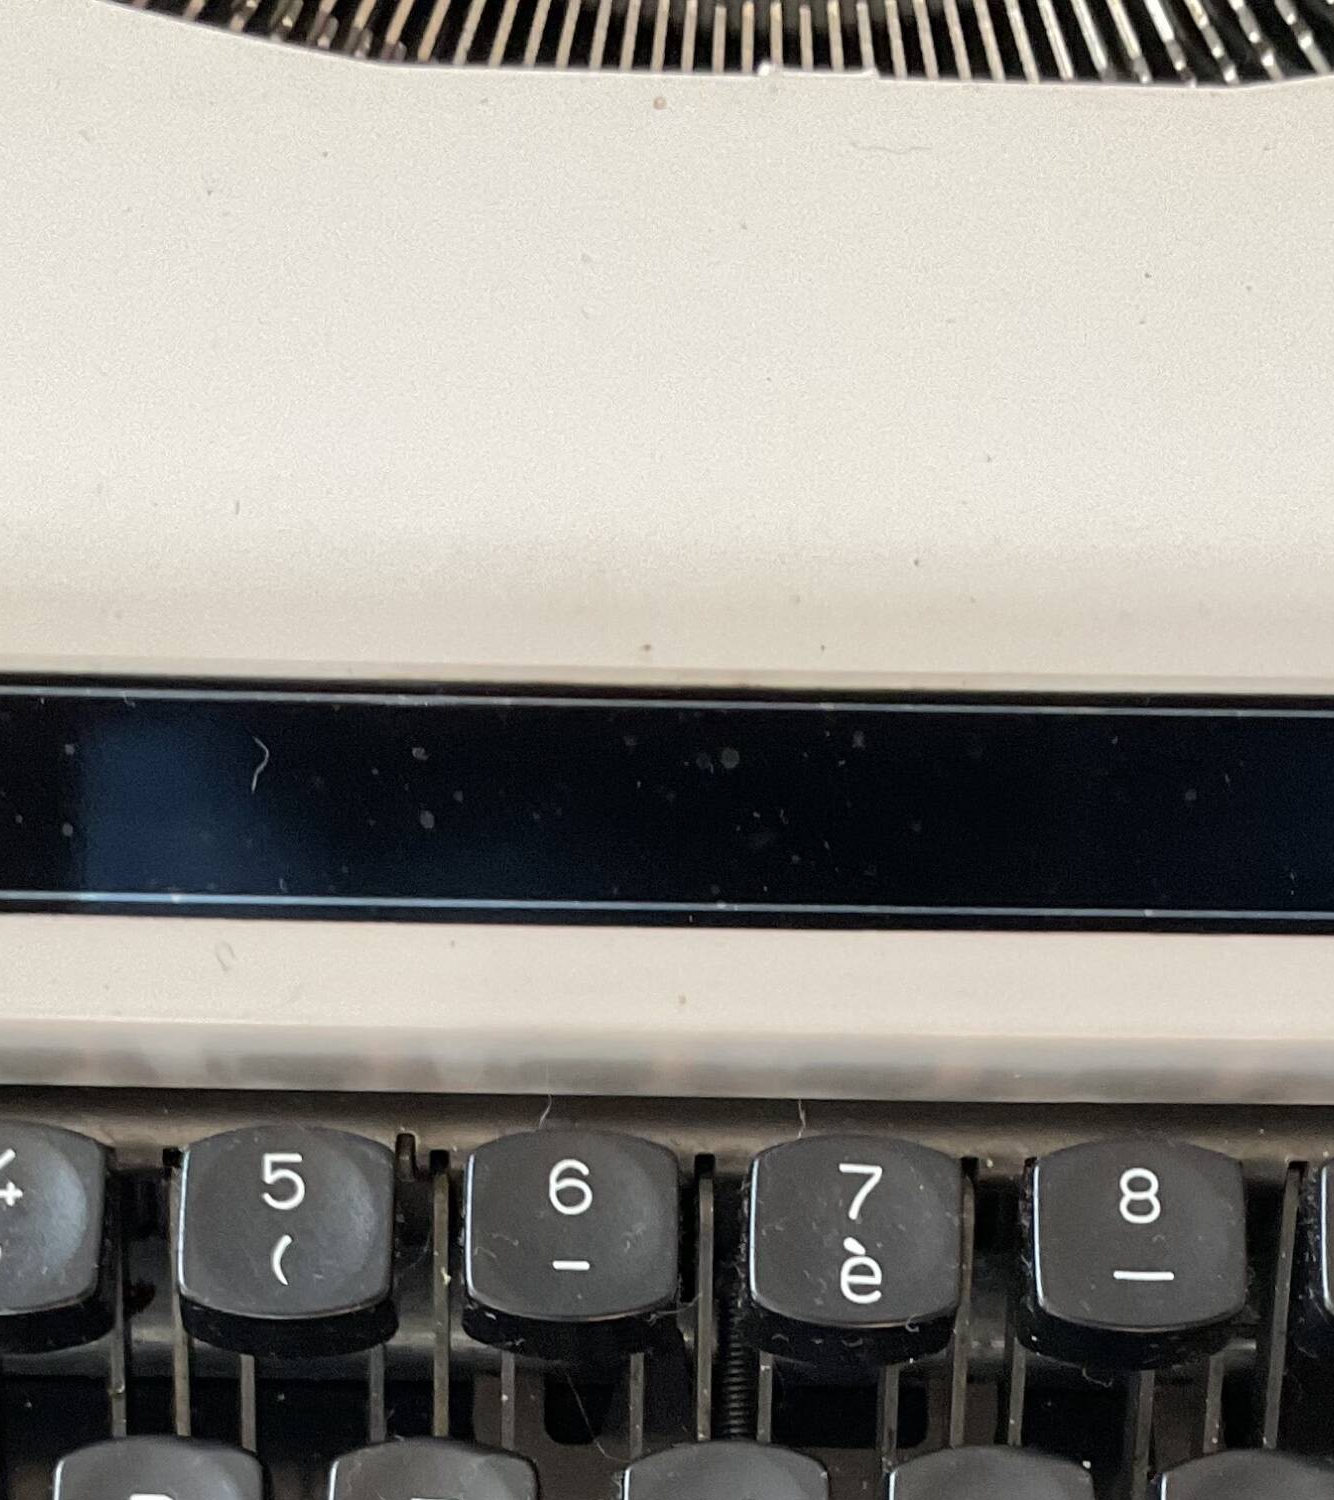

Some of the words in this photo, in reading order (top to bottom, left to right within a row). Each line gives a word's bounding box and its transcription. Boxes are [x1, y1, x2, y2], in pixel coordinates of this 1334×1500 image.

[262, 1153, 305, 1210] 5
[549, 1159, 593, 1215] 6
[839, 1163, 883, 1220] 7
[1119, 1167, 1161, 1224] 8
[272, 1235, 292, 1286] (
[840, 1237, 882, 1304] è
